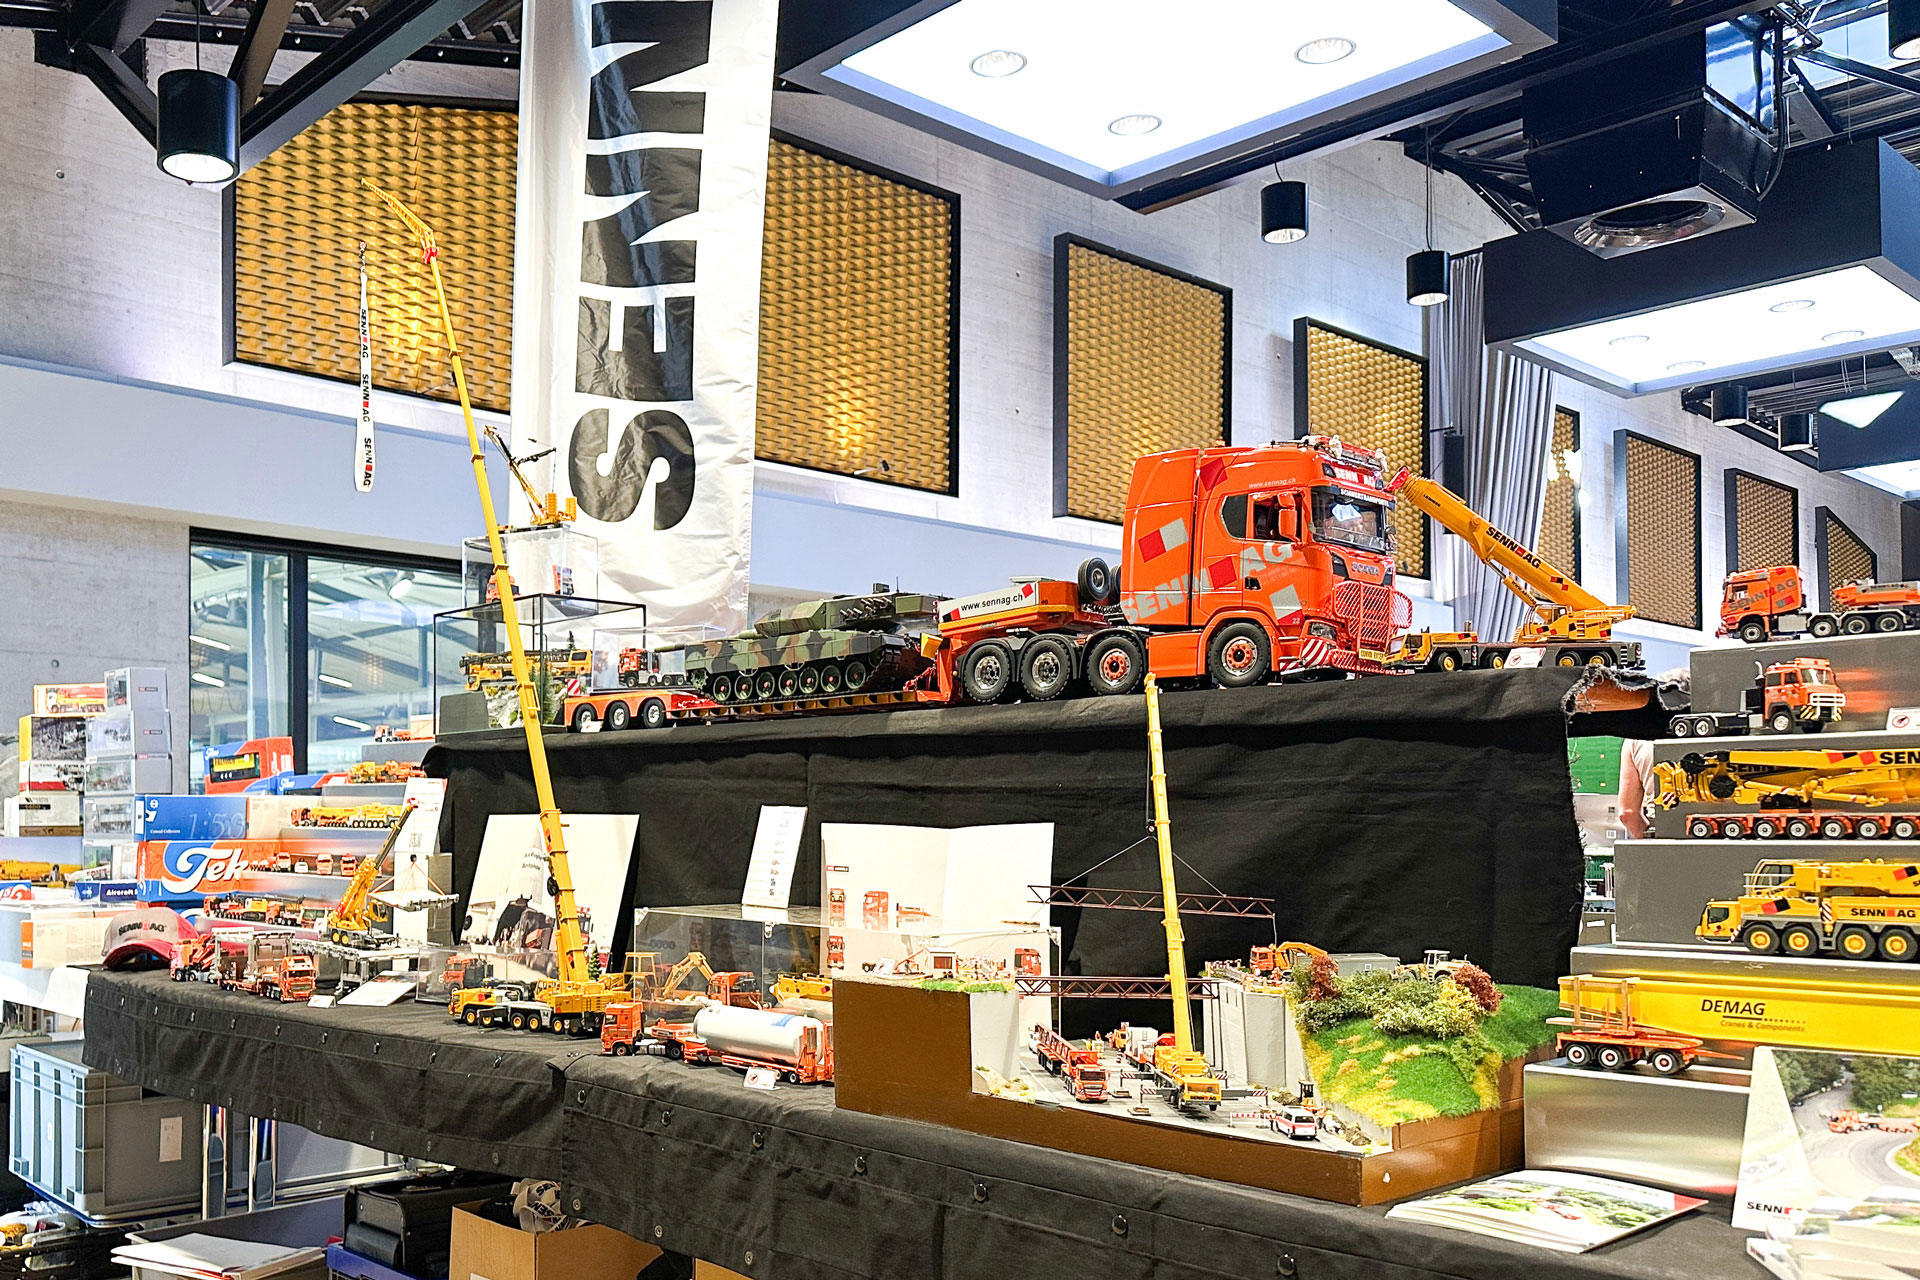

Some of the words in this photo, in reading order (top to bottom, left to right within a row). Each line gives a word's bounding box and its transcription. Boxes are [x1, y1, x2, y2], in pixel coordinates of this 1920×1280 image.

[568, 1, 713, 530] SENN
[361, 308, 369, 337] SENN
[362, 343, 369, 358] AG
[362, 373, 370, 402] SENN
[362, 408, 371, 422] AG
[363, 437, 373, 464] SENN
[363, 472, 373, 487] AG
[1248, 477, 1297, 489] www.sennag.ch
[1335, 468, 1359, 483] SENN
[1363, 474, 1377, 488] AG
[1485, 526, 1519, 552] SENN
[1522, 552, 1542, 569] AG
[1351, 562, 1380, 575] SCANIA
[1120, 567, 1210, 625] SENN
[1240, 542, 1293, 579] AG
[1729, 591, 1765, 611] SENN
[1777, 578, 1797, 592] AG
[961, 594, 1023, 612] www.sennag.ch
[1879, 751, 1920, 765] SEN
[162, 847, 249, 894] Tek
[1851, 908, 1886, 917] SENN
[1897, 909, 1916, 918] AG
[119, 921, 142, 936] SENN
[150, 923, 165, 932] AG
[1701, 999, 1766, 1015] DEMAG
[1720, 1020, 1746, 1028] Cranes
[1755, 1022, 1805, 1032] Components
[1747, 1201, 1783, 1214] SENN
